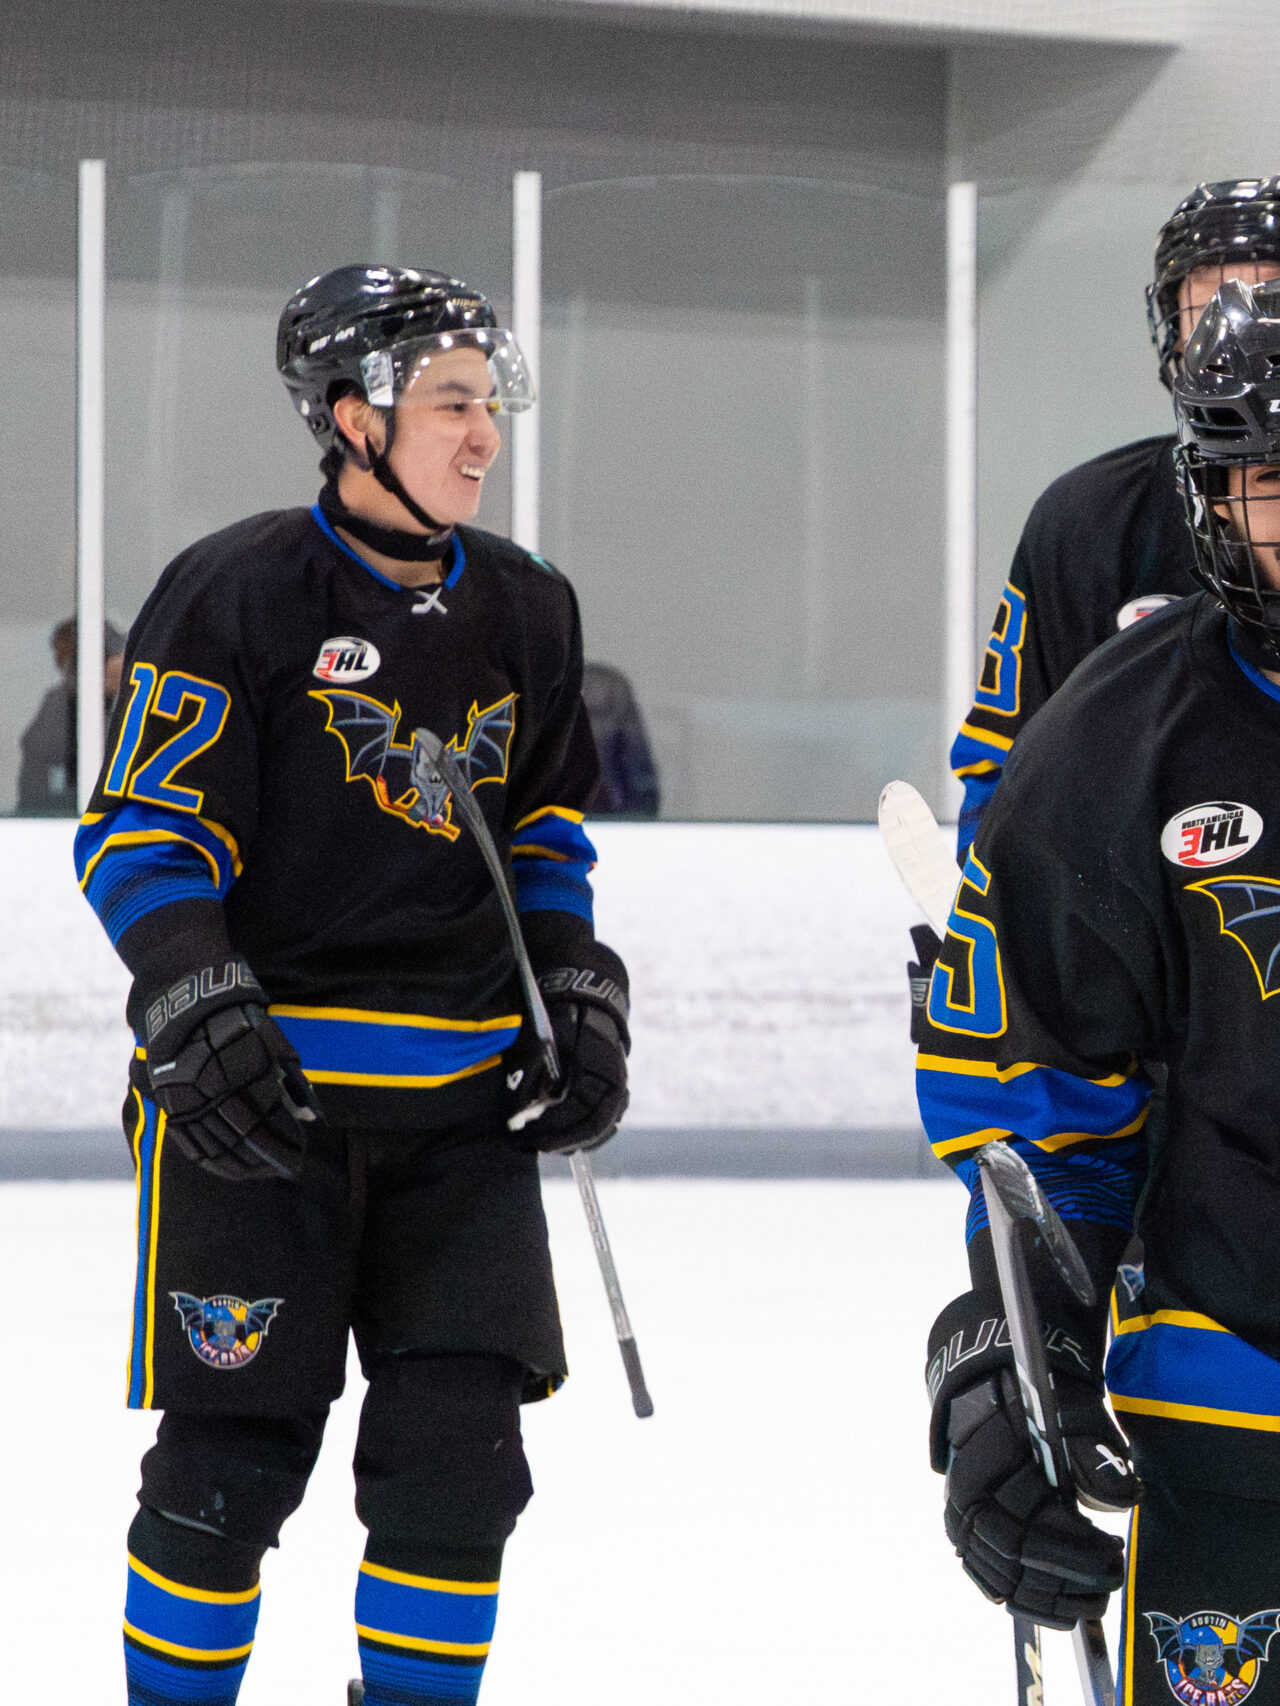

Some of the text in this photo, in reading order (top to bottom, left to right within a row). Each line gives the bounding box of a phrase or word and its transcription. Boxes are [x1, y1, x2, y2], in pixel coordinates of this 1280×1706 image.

[316, 648, 370, 672] 3HL
[103, 662, 231, 815] 12
[1178, 818, 1250, 859] 3HL
[927, 841, 1008, 1039] 5
[1191, 1616, 1228, 1628] AUSTIN
